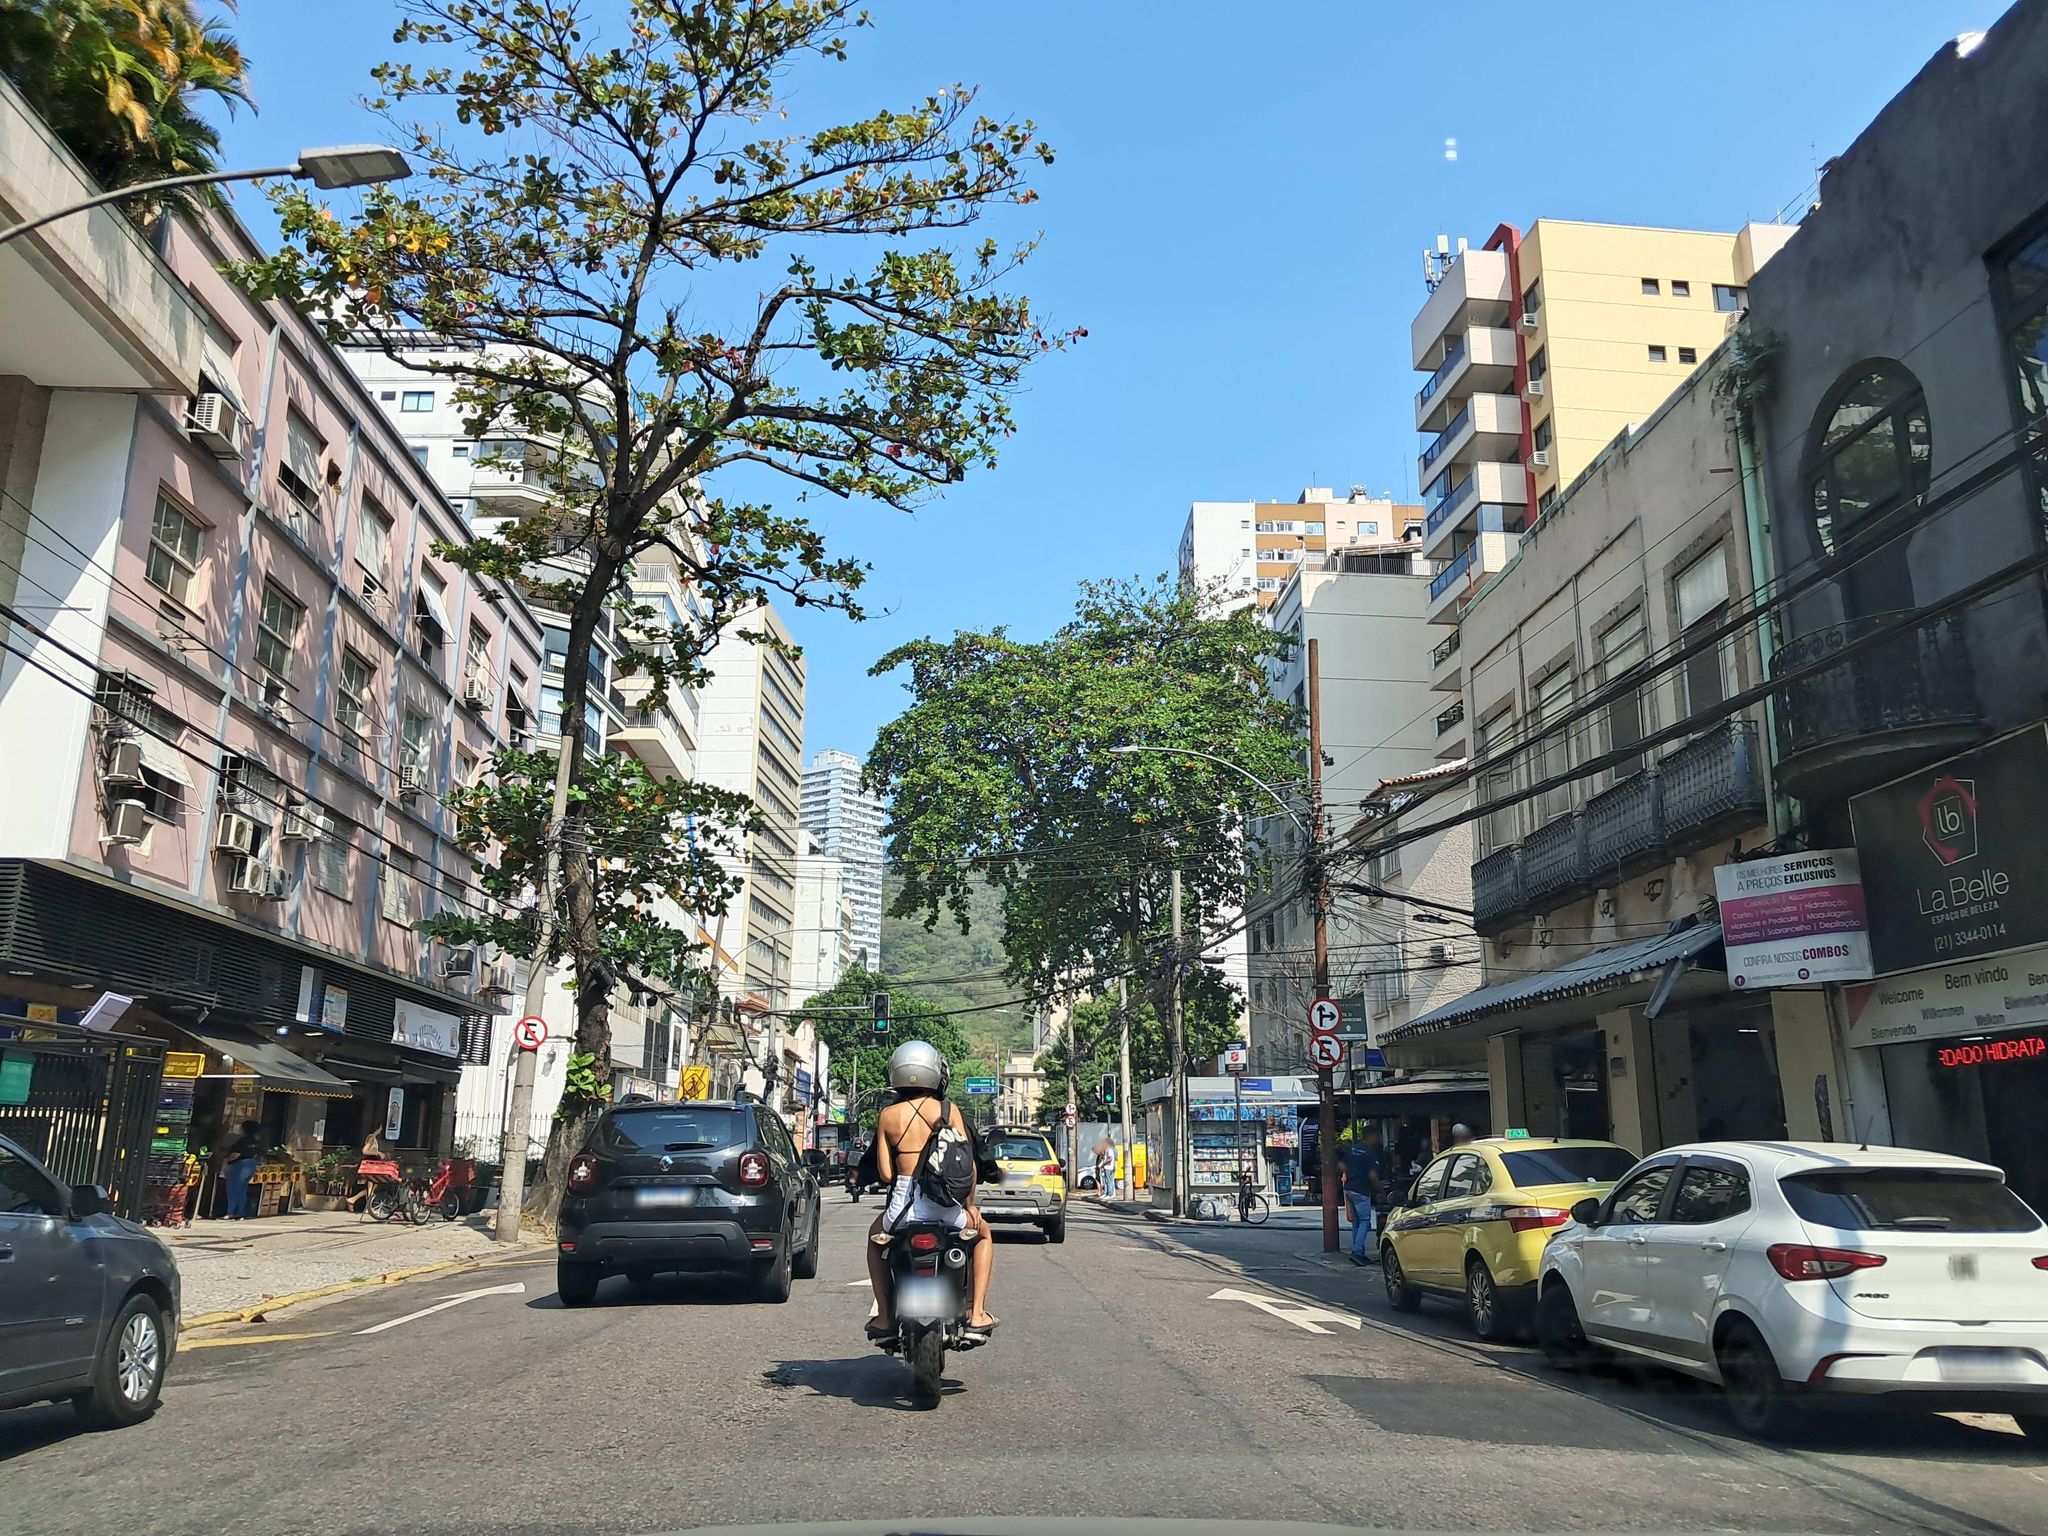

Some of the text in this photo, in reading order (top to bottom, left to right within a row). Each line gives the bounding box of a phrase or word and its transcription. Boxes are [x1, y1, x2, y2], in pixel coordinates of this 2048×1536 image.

[1736, 856, 1834, 879] OS MELHORES SERVIÇOS
[1737, 868, 1836, 891] A PREÇOS EXCLUSIVOS
[1917, 868, 2010, 915] La Belle
[1730, 920, 1761, 930] Manicure
[1768, 914, 1799, 926] Pedicure
[1932, 900, 1999, 925] ESPAÇO DE BELEZA
[1767, 923, 1812, 936] Sobrancelha
[1819, 919, 1861, 930] Depilação
[1934, 922, 2006, 952] (21) 3344-0114
[1743, 944, 1850, 968] CONFIRA NOSSOS COMBOS
[1945, 966, 2009, 990] Bem vindo
[1878, 988, 1924, 1006] Welcome
[1871, 1024, 1917, 1040] Bienvenido
[1508, 1129, 1527, 1138] TAXI
